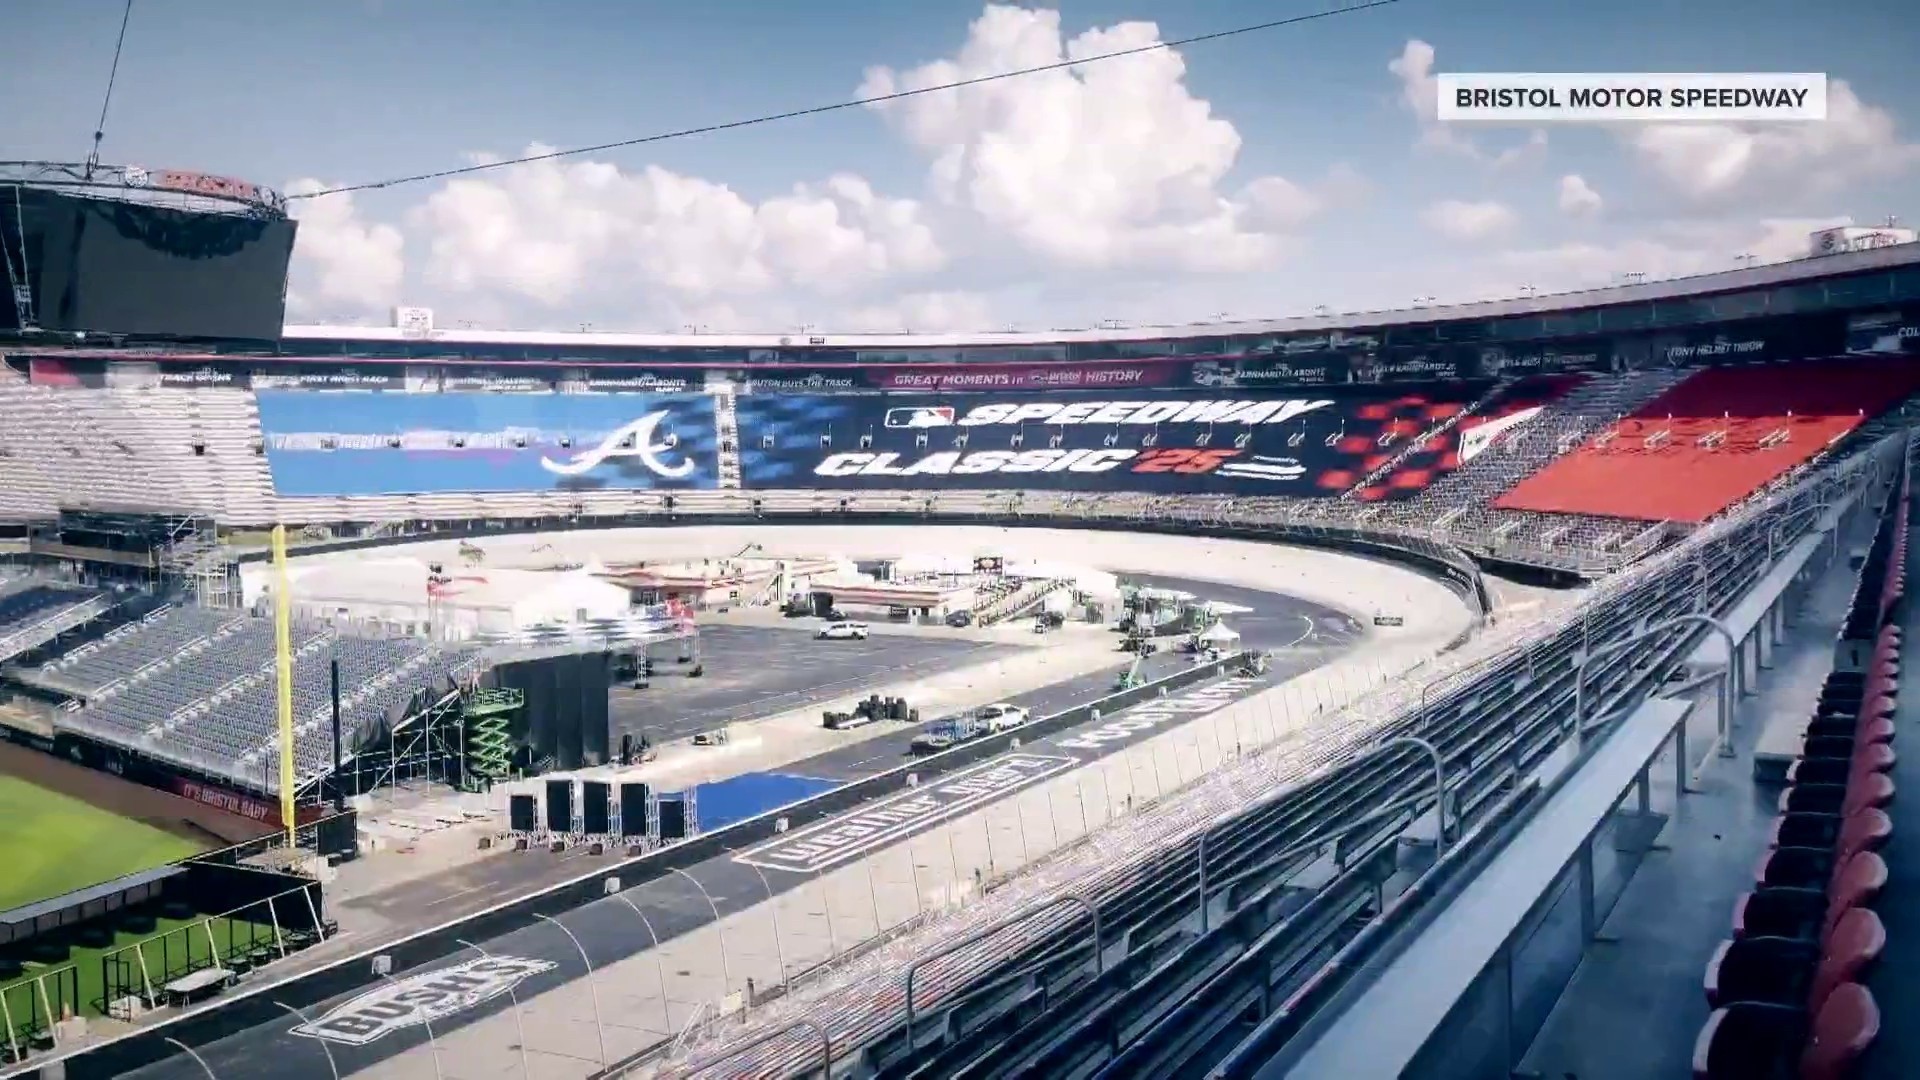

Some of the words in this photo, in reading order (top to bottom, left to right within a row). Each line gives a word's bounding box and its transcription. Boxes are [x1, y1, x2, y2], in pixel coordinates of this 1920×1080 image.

[825, 377, 853, 387] TRACK
[895, 375, 940, 385] GREAT
[943, 374, 1009, 385] MOMENTS
[1012, 375, 1023, 385] in
[1085, 370, 1144, 382] HISTORY
[957, 400, 1335, 426] SPEEDWAY
[813, 449, 1139, 475] CLASSIC
[240, 798, 269, 821] BABY
